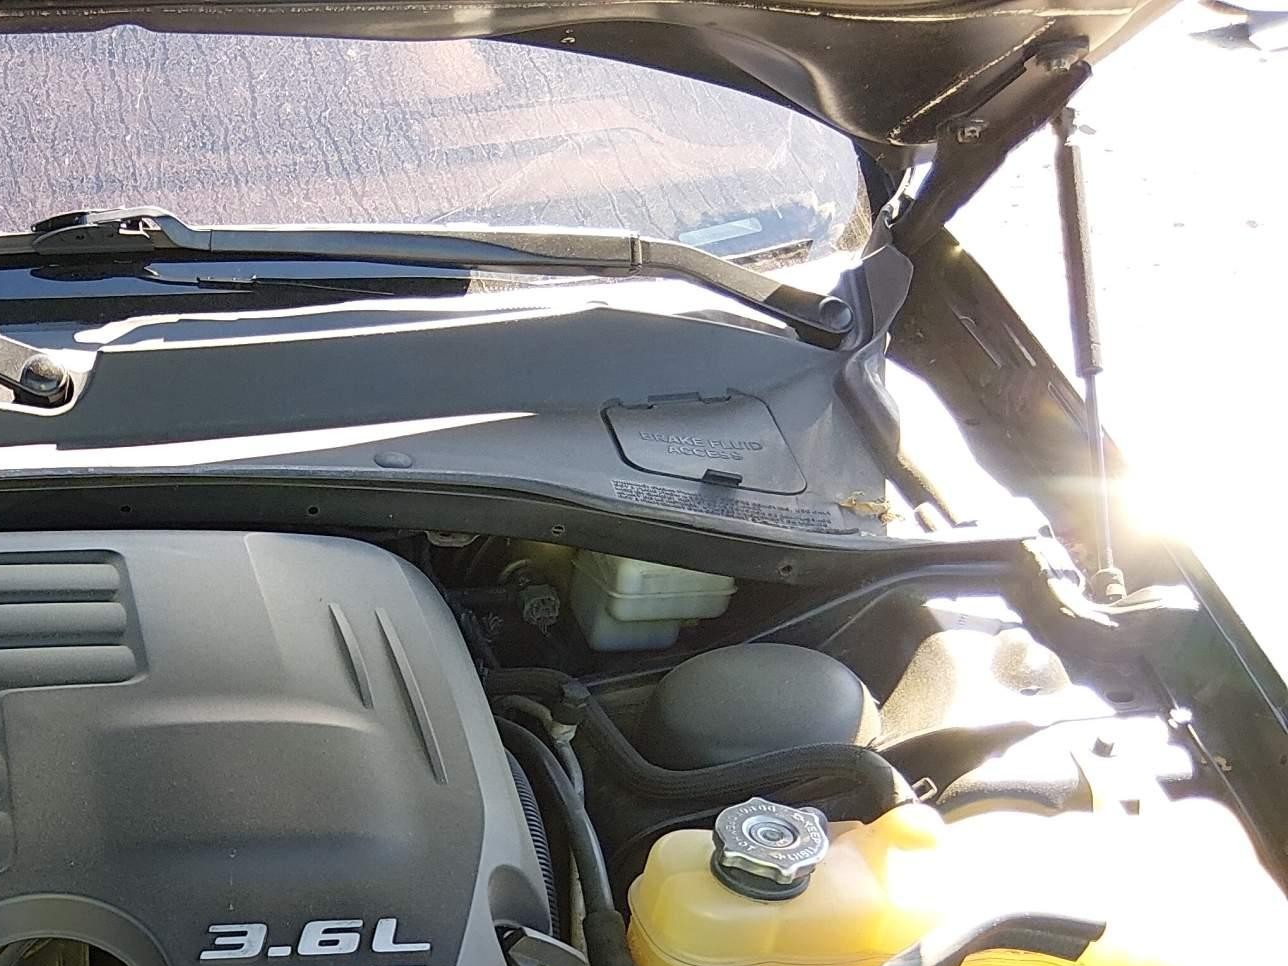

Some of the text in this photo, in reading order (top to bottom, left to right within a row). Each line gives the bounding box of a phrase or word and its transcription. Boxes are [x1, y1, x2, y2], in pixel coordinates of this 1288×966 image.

[639, 431, 764, 451] BRAKE FLUID
[667, 446, 744, 461] ACCESS
[803, 820, 822, 844] KEEP
[199, 918, 431, 960] 3.6L
